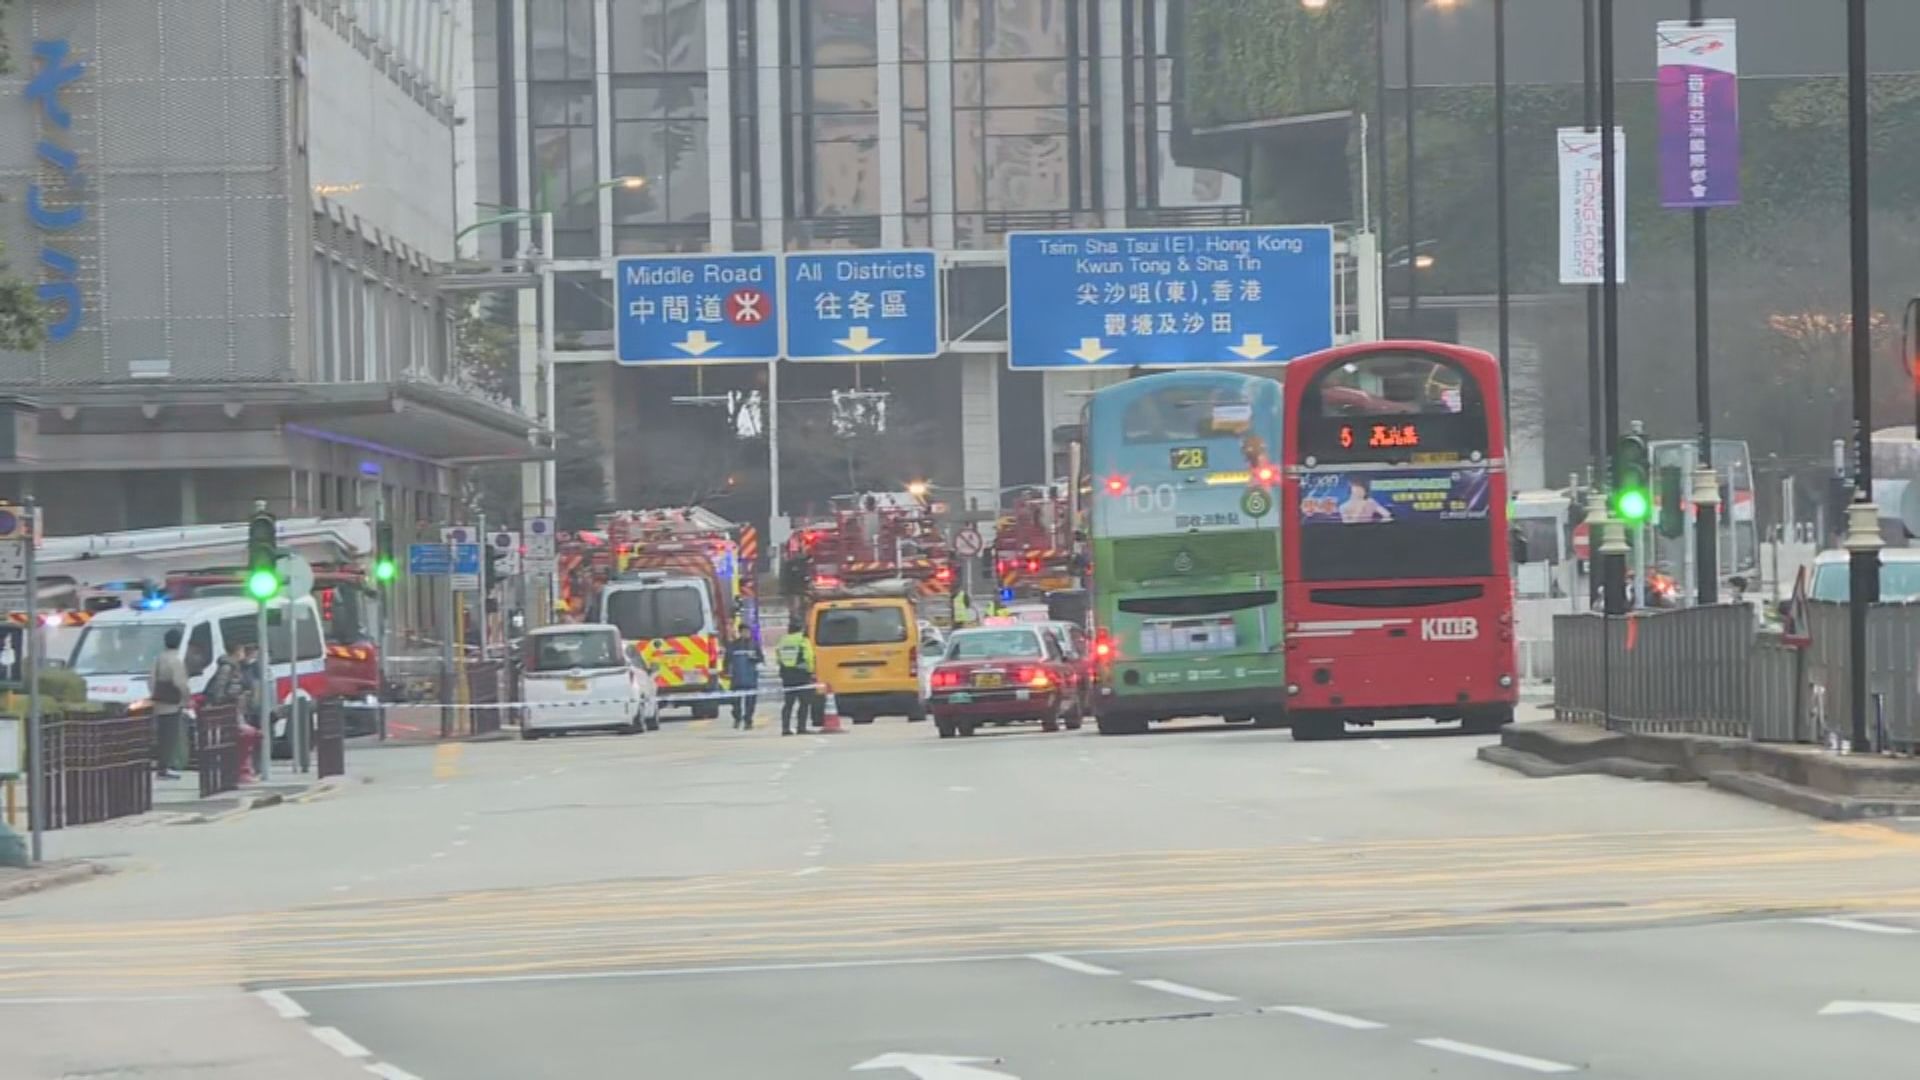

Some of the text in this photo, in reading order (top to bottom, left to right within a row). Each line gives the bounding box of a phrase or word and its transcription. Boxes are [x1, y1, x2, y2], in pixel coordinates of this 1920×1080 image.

[1583, 168, 1597, 278] HONG KONG
[1039, 239, 1078, 255] Tsim
[1085, 238, 1118, 255] Sha
[1125, 237, 1160, 254] Tsui
[1206, 235, 1250, 254] Hong
[1257, 234, 1303, 253] Kong
[626, 263, 762, 286] Middle Road
[796, 260, 926, 283] All Districts
[1076, 253, 1262, 275] Kwun Tong & Sha Tin
[629, 294, 724, 325] 中間道
[814, 290, 909, 320] 往各區
[1104, 312, 1232, 337] 觀塘及沙田
[1177, 449, 1203, 469] 28
[1421, 616, 1479, 640] KMB
